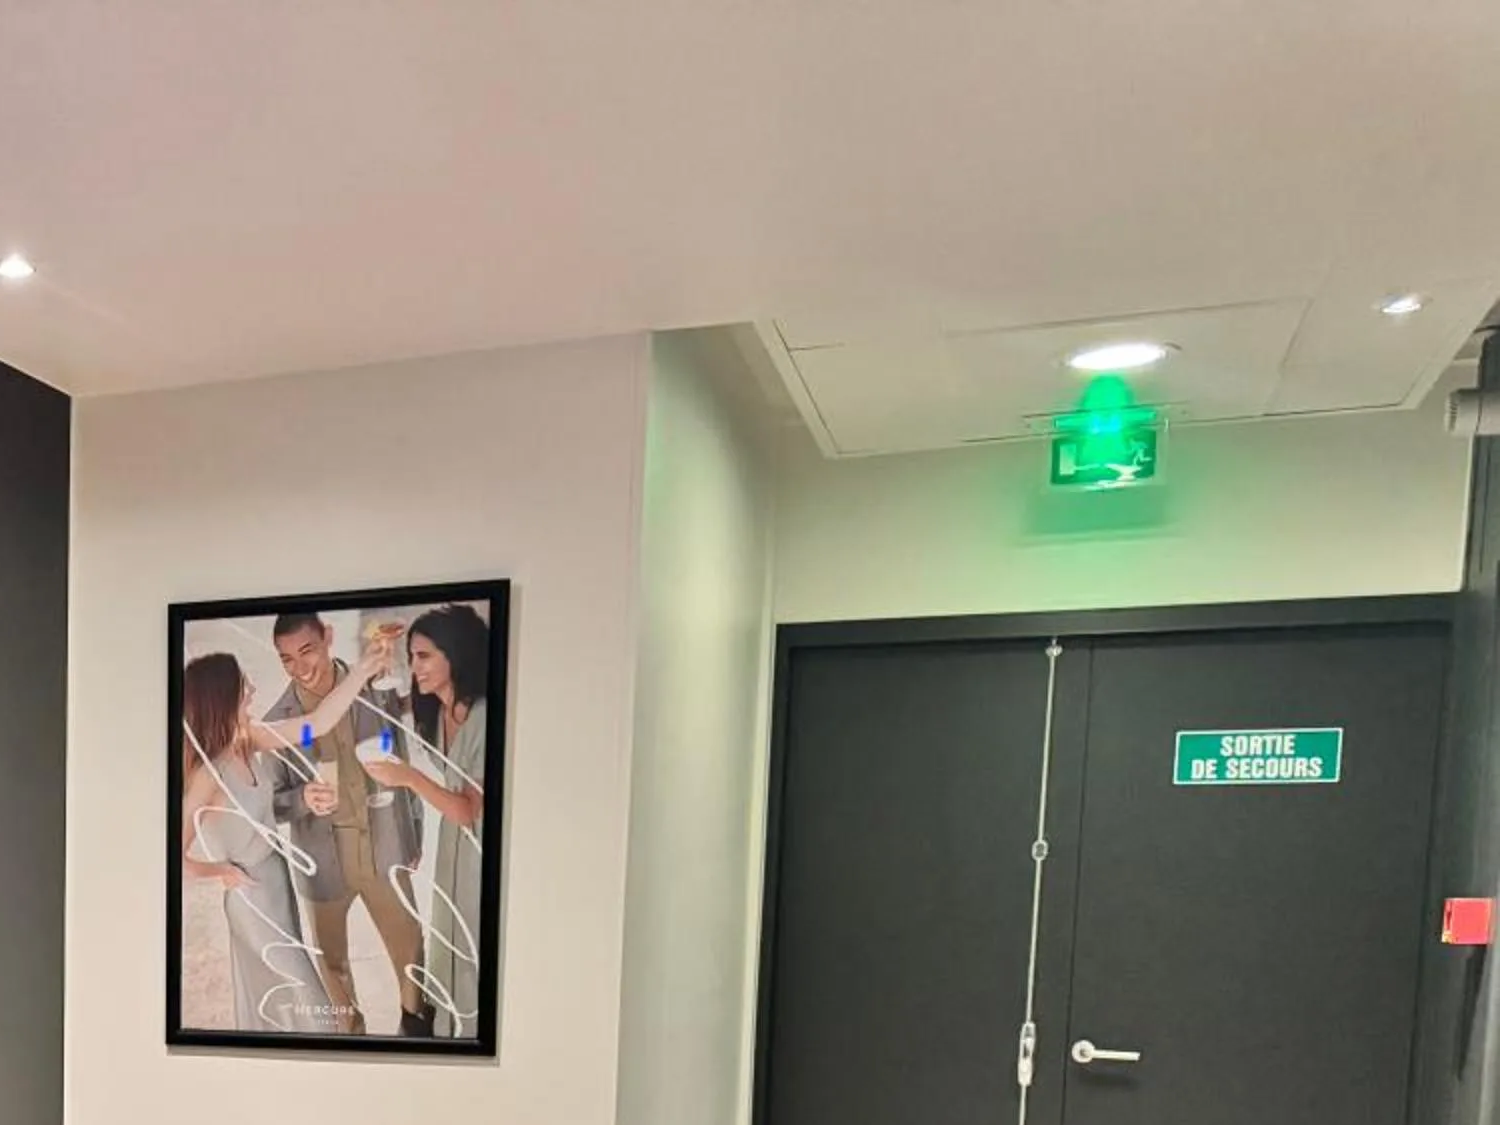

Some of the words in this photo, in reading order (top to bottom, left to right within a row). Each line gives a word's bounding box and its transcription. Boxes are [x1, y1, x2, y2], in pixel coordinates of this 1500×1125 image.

[1220, 735, 1296, 756] SORTIE
[1191, 759, 1218, 779] DE
[1225, 757, 1323, 778] SECOURS
